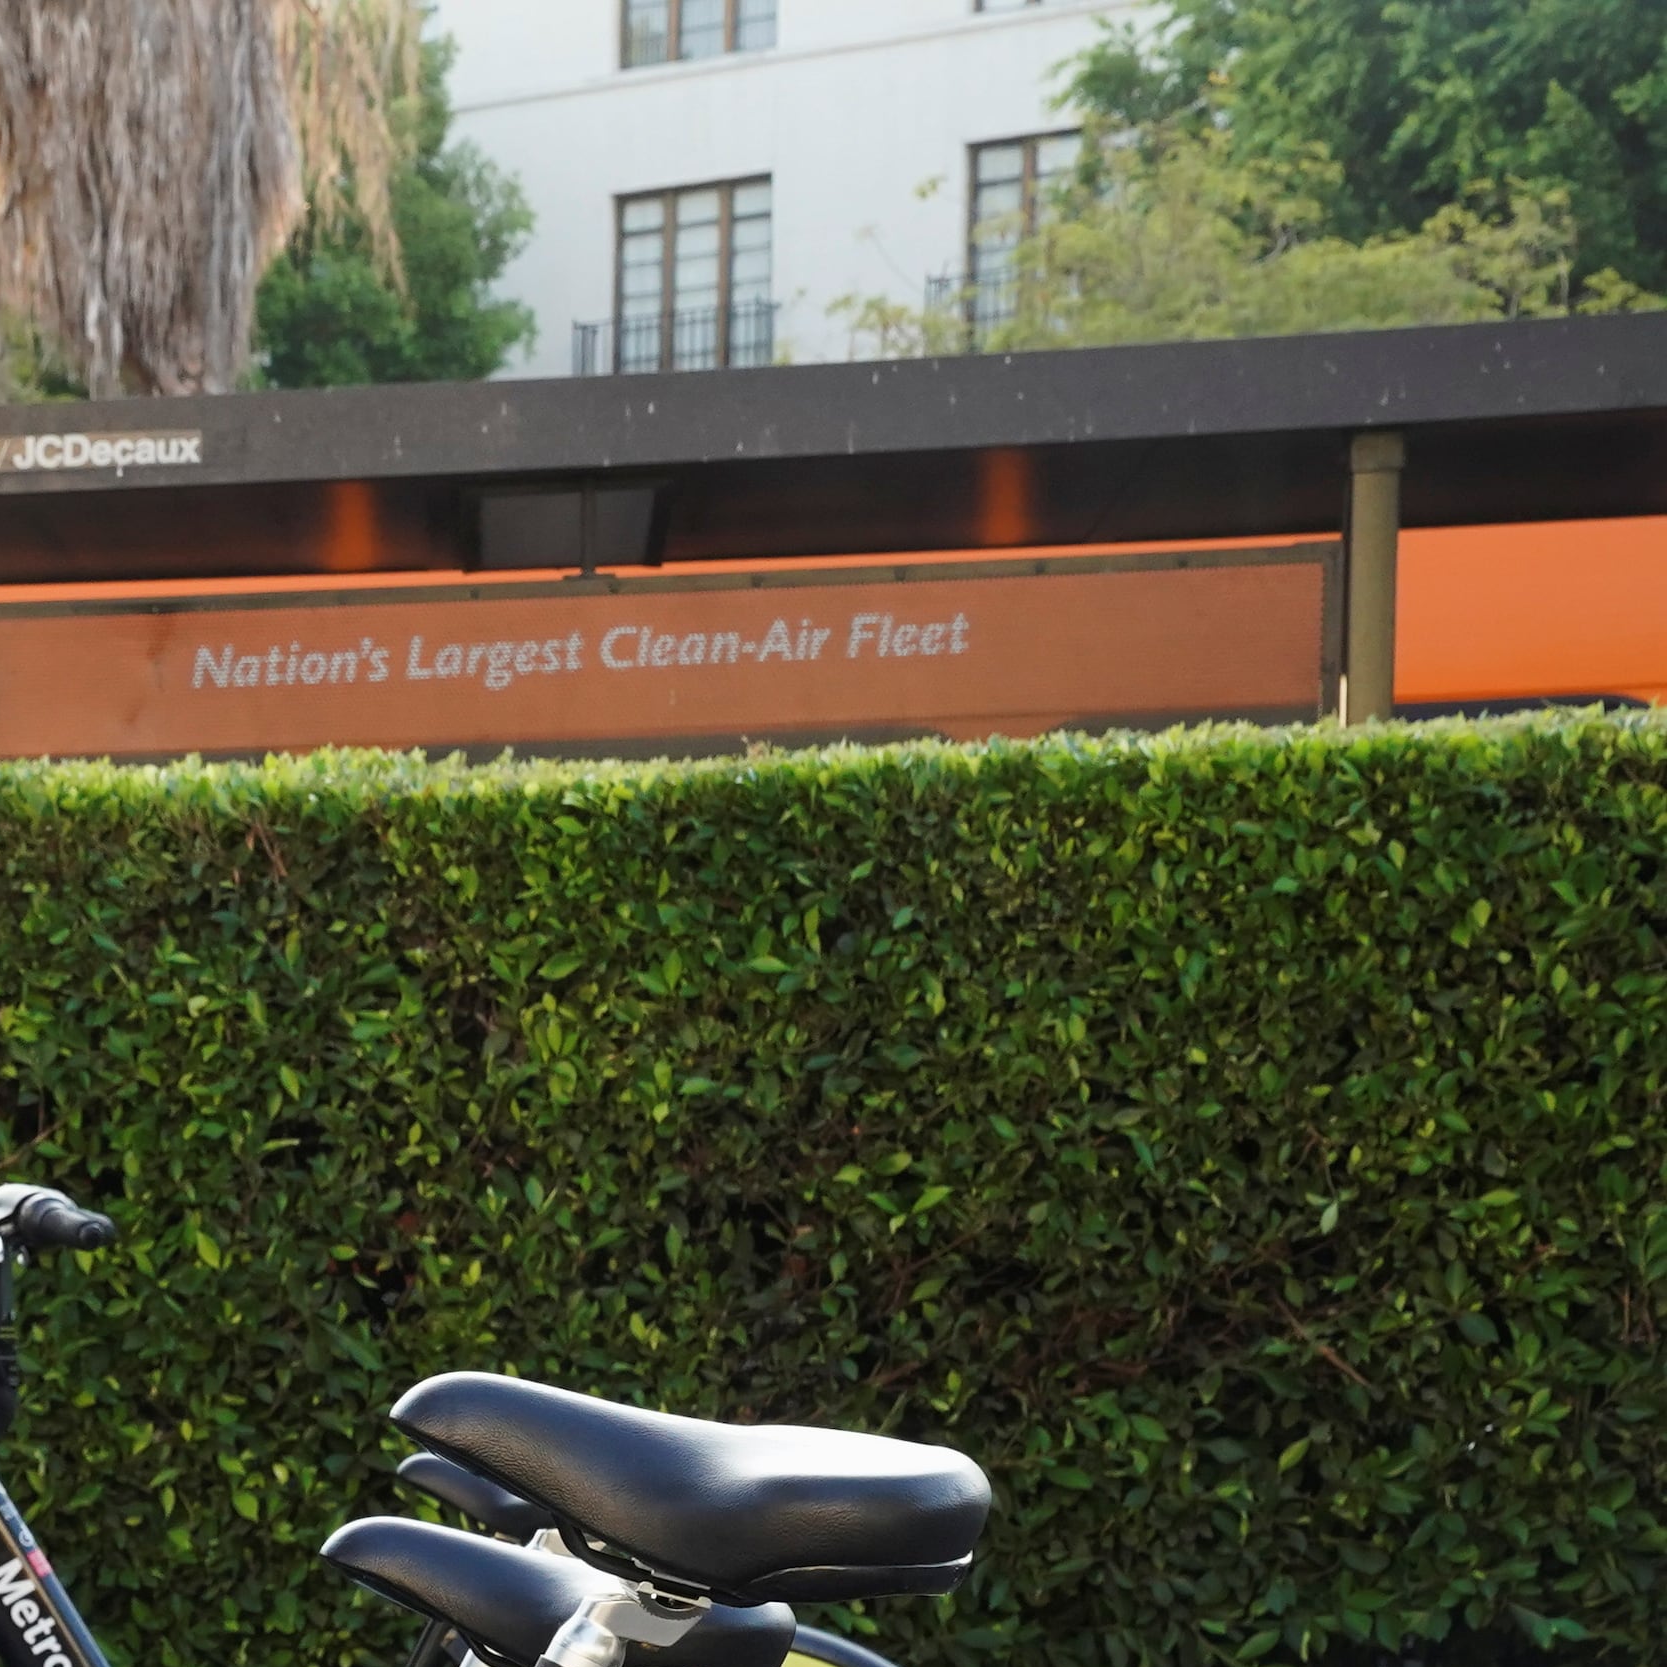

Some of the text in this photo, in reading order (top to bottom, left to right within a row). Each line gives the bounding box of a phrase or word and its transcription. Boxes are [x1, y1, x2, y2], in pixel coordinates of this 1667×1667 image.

[190, 612, 970, 690] Nation's Largest Clean-Air Fleet
